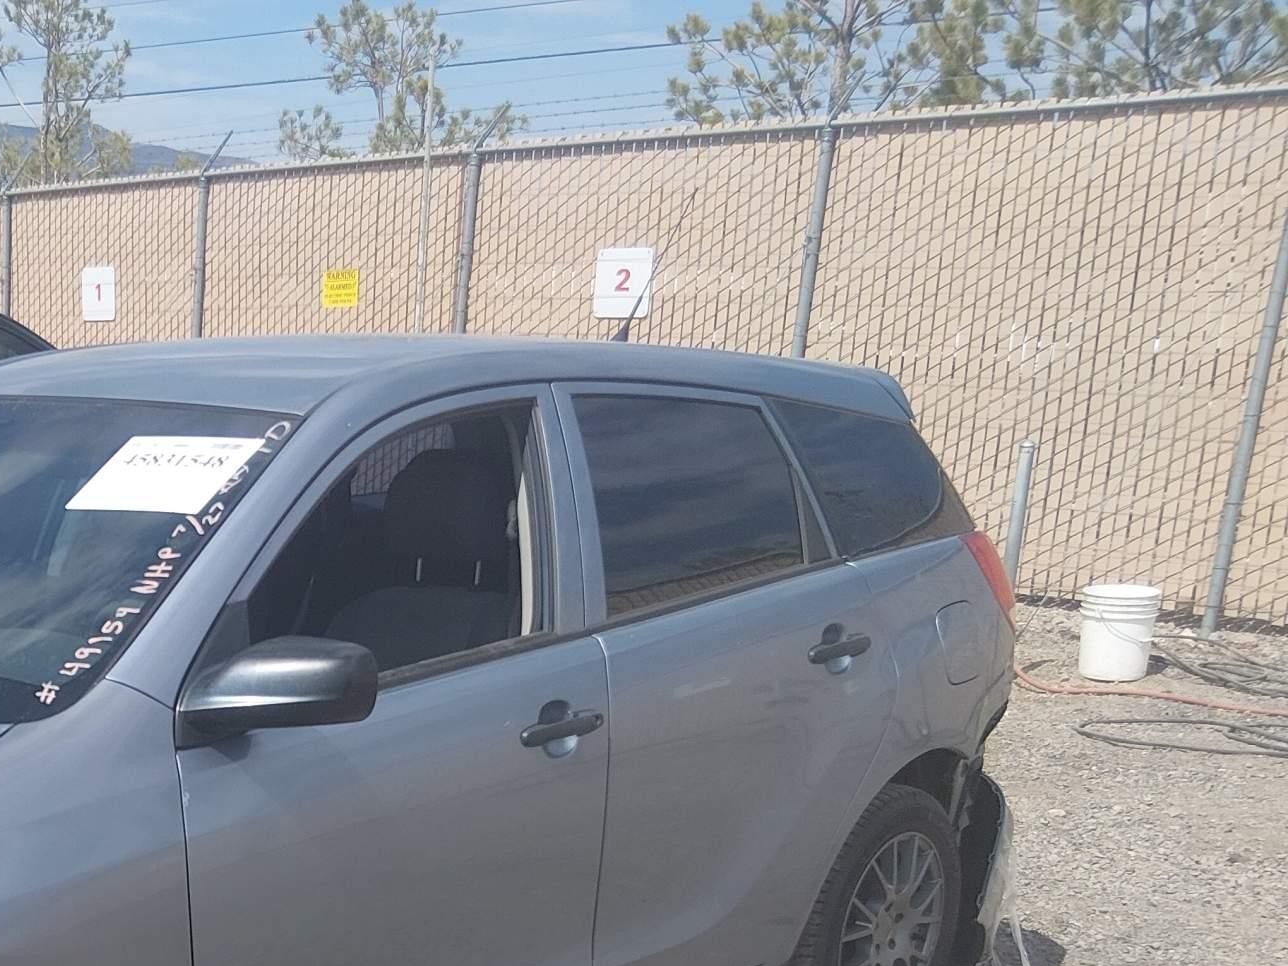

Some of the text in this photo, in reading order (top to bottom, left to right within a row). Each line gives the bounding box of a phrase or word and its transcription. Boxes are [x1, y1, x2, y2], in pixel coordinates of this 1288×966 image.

[326, 271, 356, 281] WARNING
[614, 268, 631, 293] 2
[95, 283, 102, 302] 1
